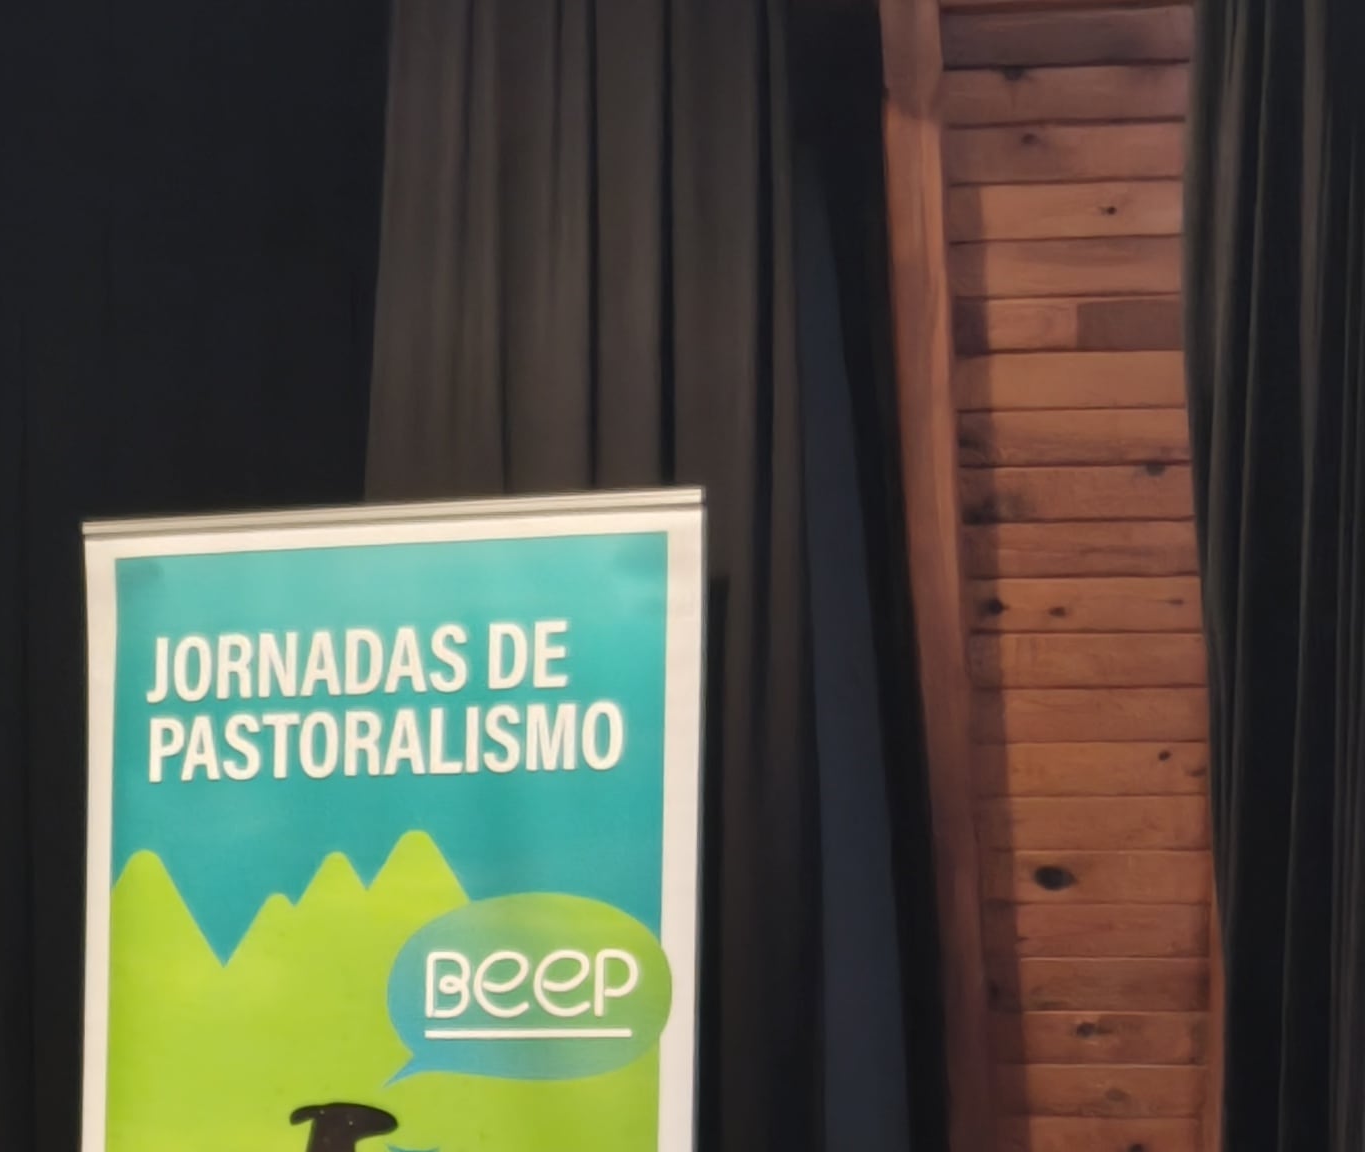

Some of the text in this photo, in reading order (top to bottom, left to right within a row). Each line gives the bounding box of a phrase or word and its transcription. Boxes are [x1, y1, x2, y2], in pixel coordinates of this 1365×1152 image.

[146, 619, 569, 704] JORNADAS DE
[148, 700, 624, 783] PASTORALISMO
